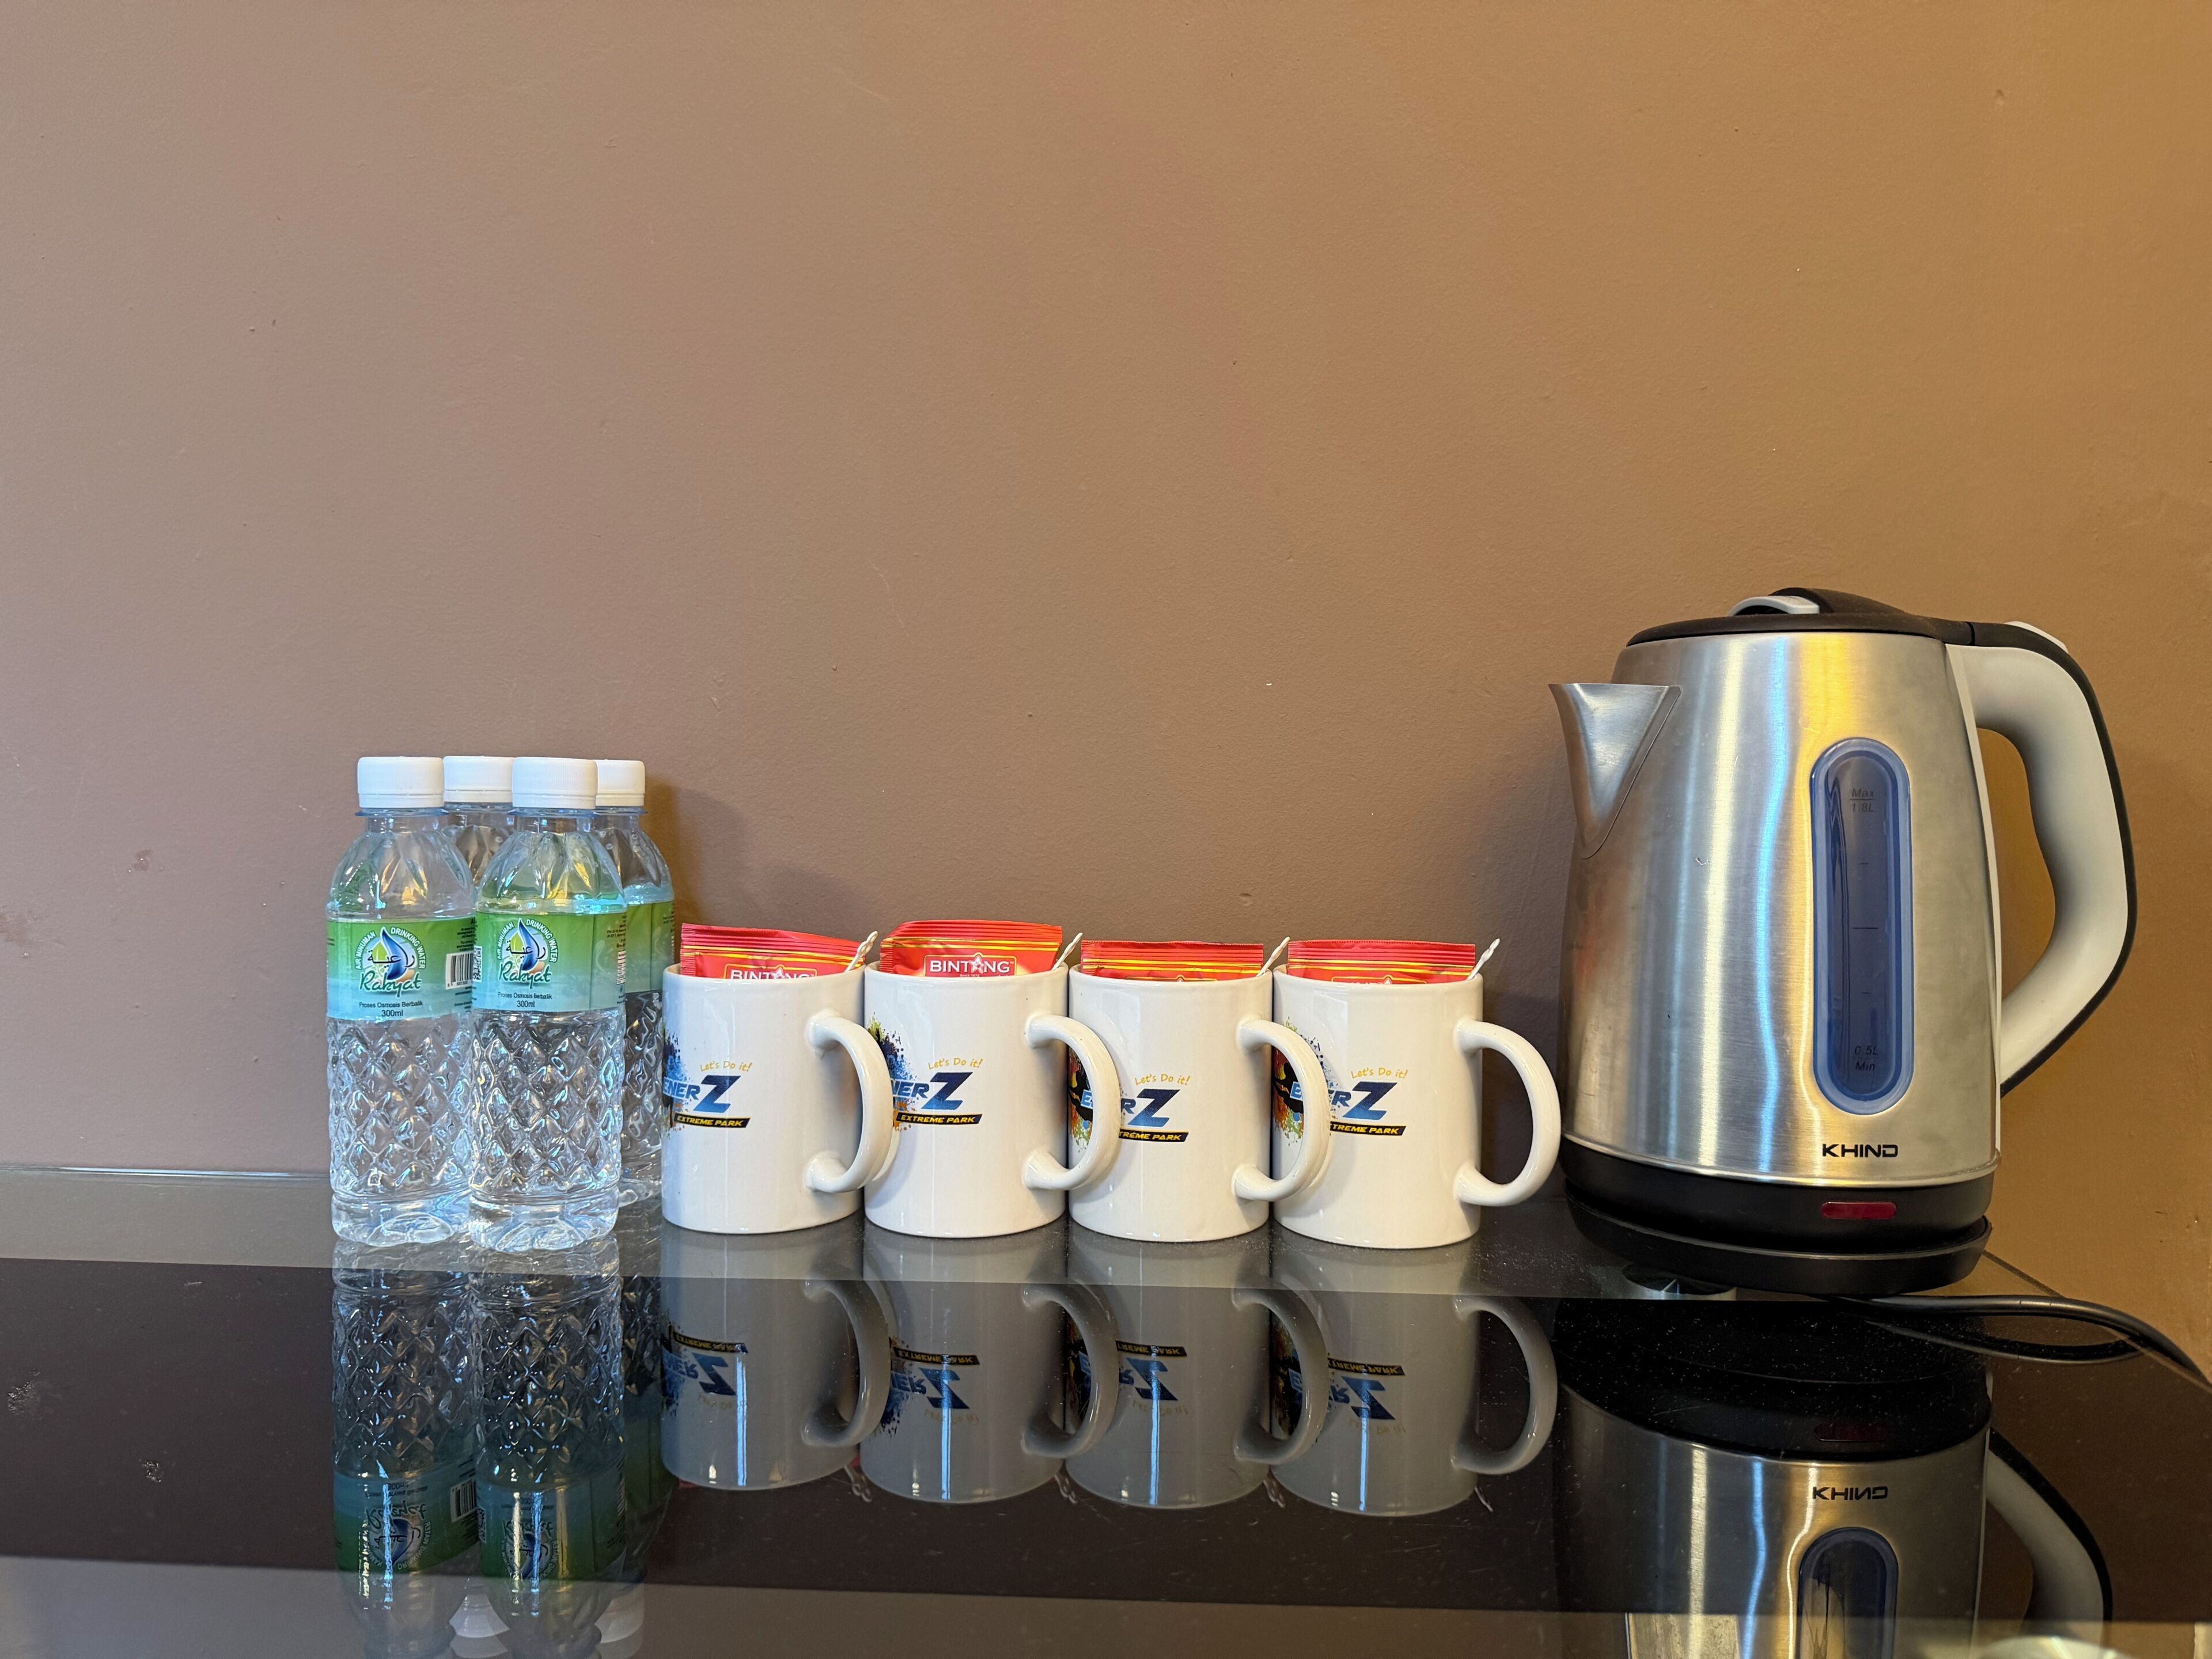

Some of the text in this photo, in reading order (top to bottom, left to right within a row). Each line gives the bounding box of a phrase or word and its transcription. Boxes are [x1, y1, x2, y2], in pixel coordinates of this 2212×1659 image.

[1852, 788, 1874, 797] Max
[1853, 802, 1874, 812] 18L
[498, 922, 514, 948] MINUMAN
[526, 919, 558, 962] DRINKING WATER
[355, 931, 377, 957] MINUMAN
[391, 927, 426, 969] DRINKING WATER
[498, 960, 552, 989] Rakyat
[359, 970, 422, 998] Rakyat
[381, 1009, 404, 1017] 300ml
[1854, 1045, 1878, 1055] 05L
[700, 1060, 753, 1072] Let's Do it!
[928, 1058, 983, 1070] Let's Do it!
[1855, 1061, 1876, 1071] Min
[1350, 1067, 1409, 1079] Let's Do it!
[1134, 1074, 1191, 1085] Let's Do it!
[677, 1115, 713, 1126] EXTREME
[900, 1115, 945, 1123] EXTREME
[1822, 1143, 1899, 1158] KHIND
